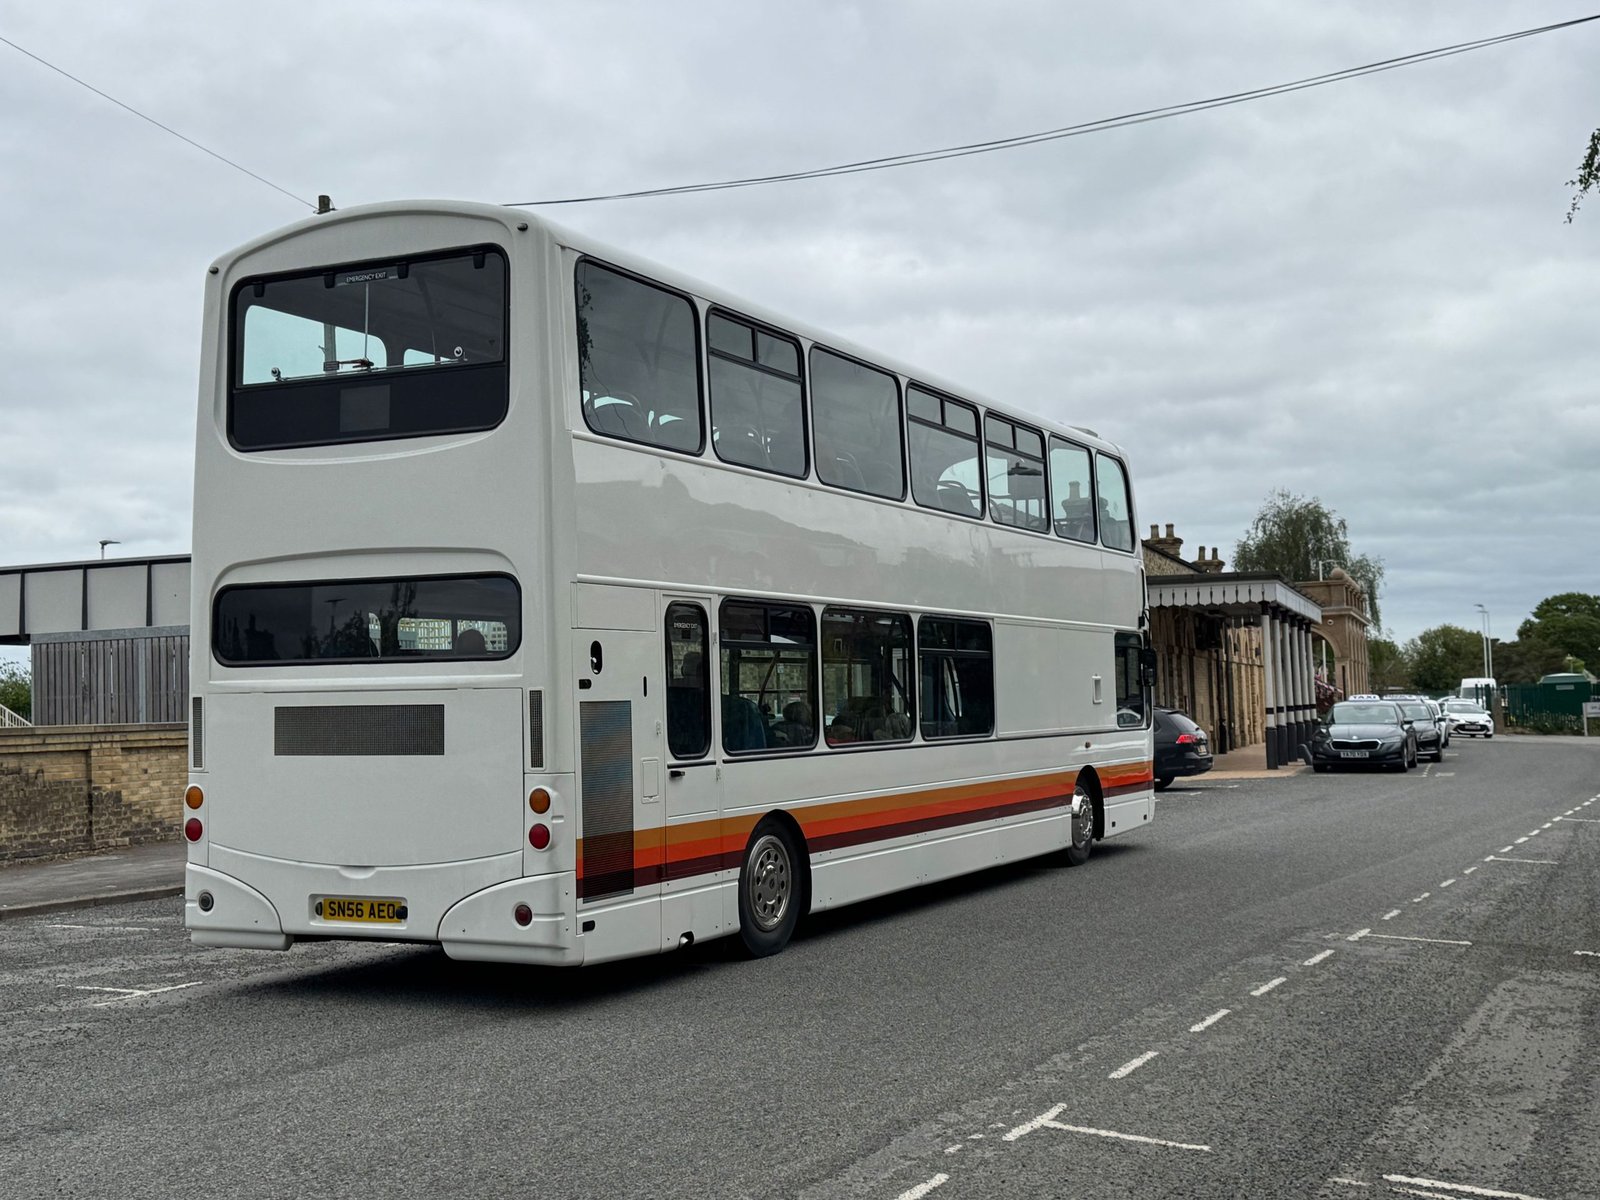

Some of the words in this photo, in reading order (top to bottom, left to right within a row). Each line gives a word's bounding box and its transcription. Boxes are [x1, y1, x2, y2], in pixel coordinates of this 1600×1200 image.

[346, 273, 374, 282] EMERGENCY
[328, 901, 364, 918] SN56
[368, 903, 396, 919] AEO
